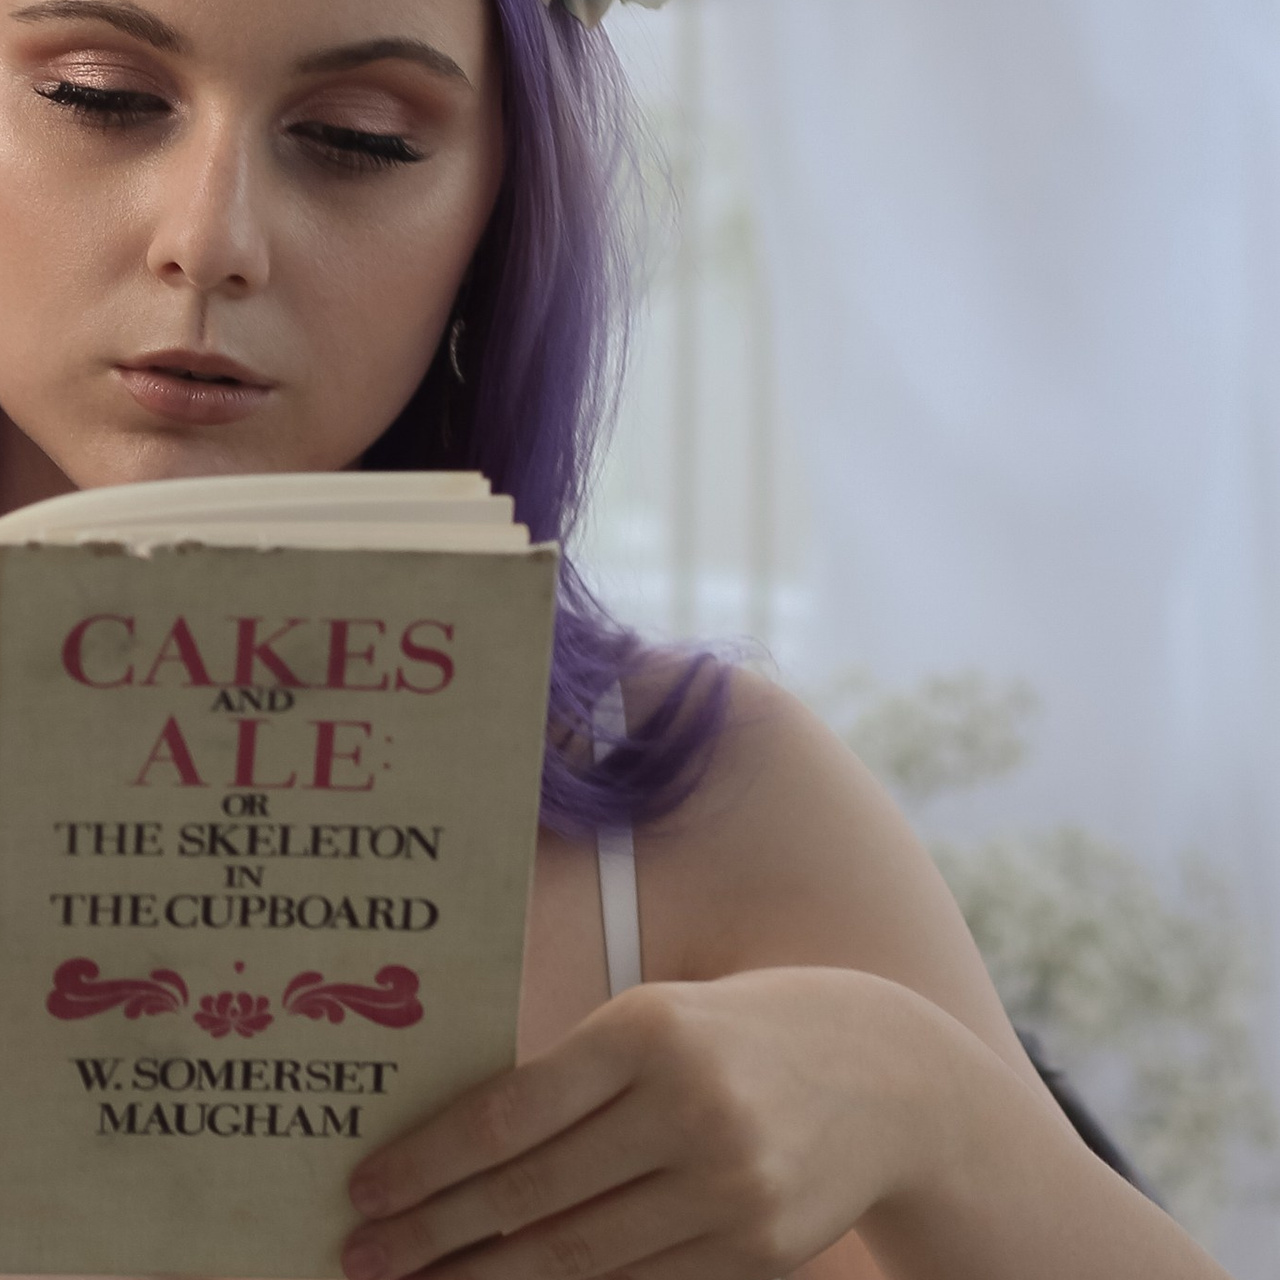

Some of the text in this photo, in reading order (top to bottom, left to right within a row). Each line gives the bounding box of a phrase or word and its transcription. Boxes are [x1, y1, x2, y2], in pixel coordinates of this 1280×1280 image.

[60, 613, 456, 695] CAKES
[210, 689, 296, 713] AND
[221, 793, 270, 818] OR
[53, 822, 444, 861] THE SKELETON
[223, 865, 266, 889] IN
[49, 893, 441, 932] THE CUPBOARD
[71, 1057, 399, 1095] W. SOMERSET
[96, 1101, 363, 1139] MAUGHAM
